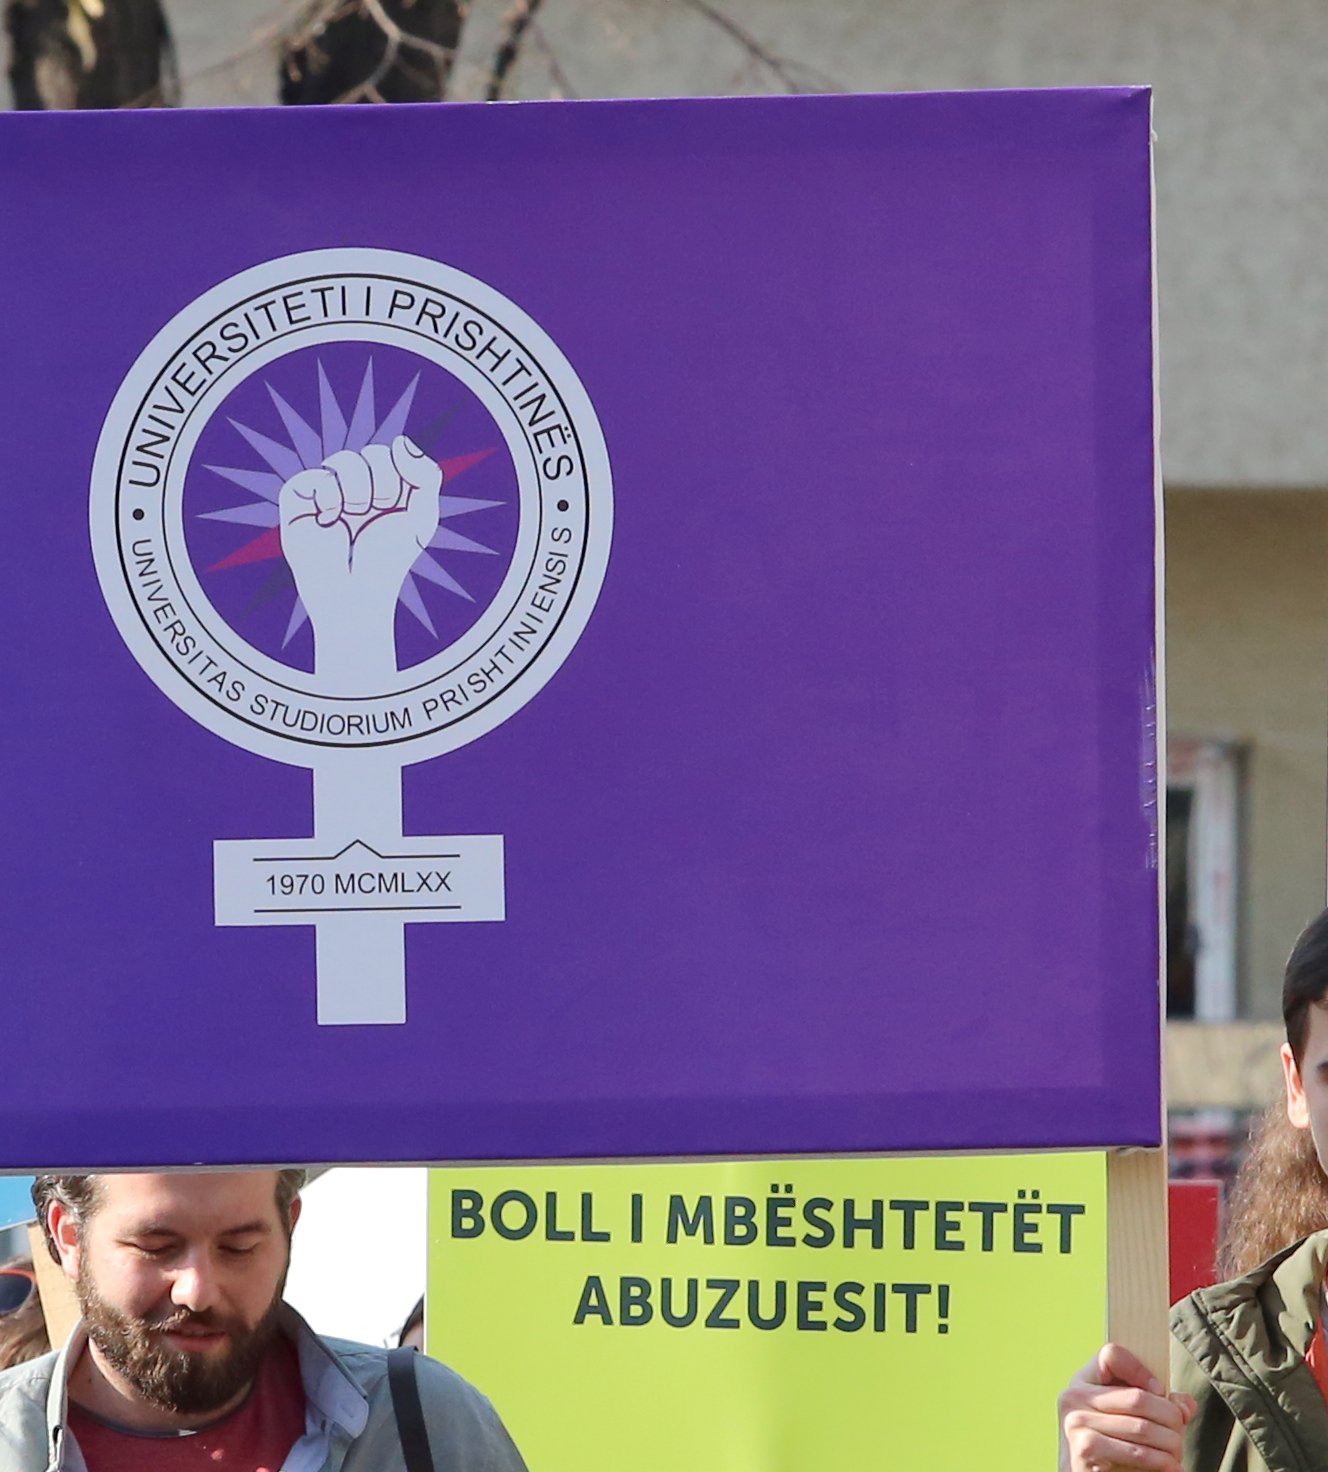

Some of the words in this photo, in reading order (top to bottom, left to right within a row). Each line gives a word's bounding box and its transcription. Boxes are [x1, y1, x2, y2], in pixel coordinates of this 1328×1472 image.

[127, 284, 349, 490] UNIVERSITETI
[364, 286, 373, 317] I
[388, 288, 575, 482] PRISHTINËS
[131, 537, 246, 704] UNIVERSITAS
[248, 692, 413, 737] STUDIORIUM
[421, 525, 572, 722] PRISHTINIENSIS
[266, 873, 325, 896] 1970
[335, 870, 453, 895] MCMLXX
[450, 1188, 612, 1243] BOLL
[630, 1193, 643, 1244] I
[666, 1183, 1086, 1255] MBËSHTETËT
[572, 1275, 951, 1335] ABUZUESIT!
